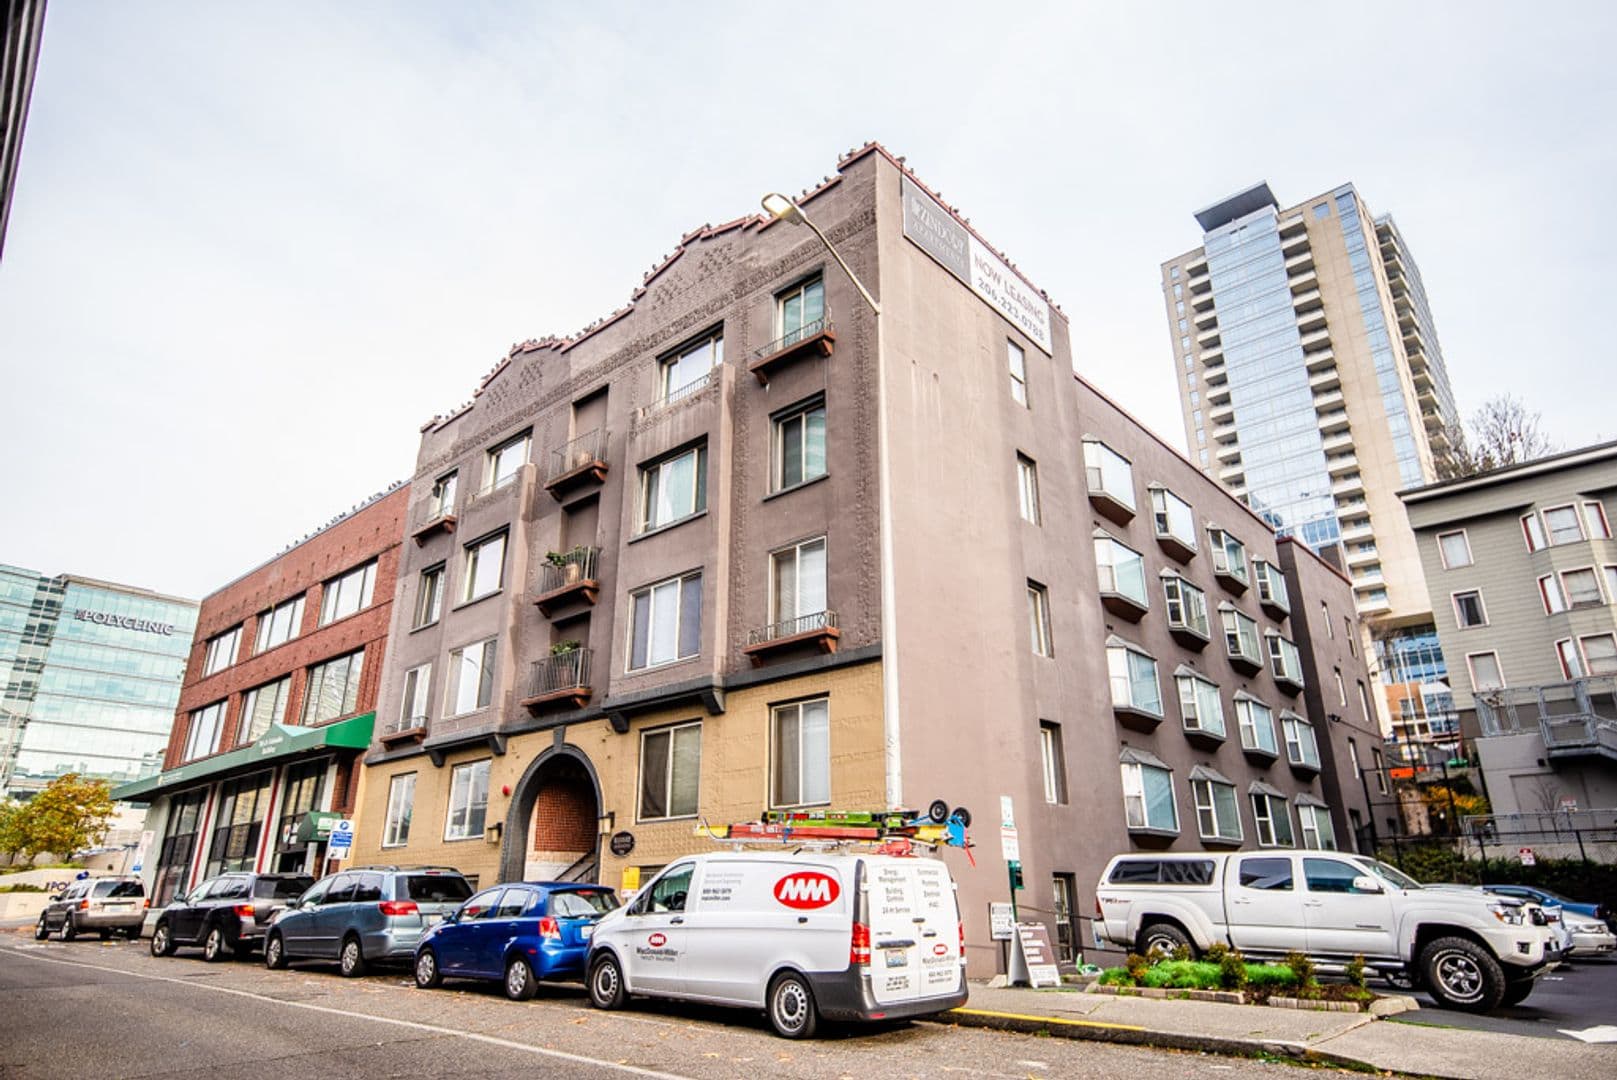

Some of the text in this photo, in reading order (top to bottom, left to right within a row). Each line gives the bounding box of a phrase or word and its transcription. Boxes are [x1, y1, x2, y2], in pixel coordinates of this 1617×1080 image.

[974, 252, 1044, 325] NOW LEASING
[83, 610, 174, 635] POLYCLINIC
